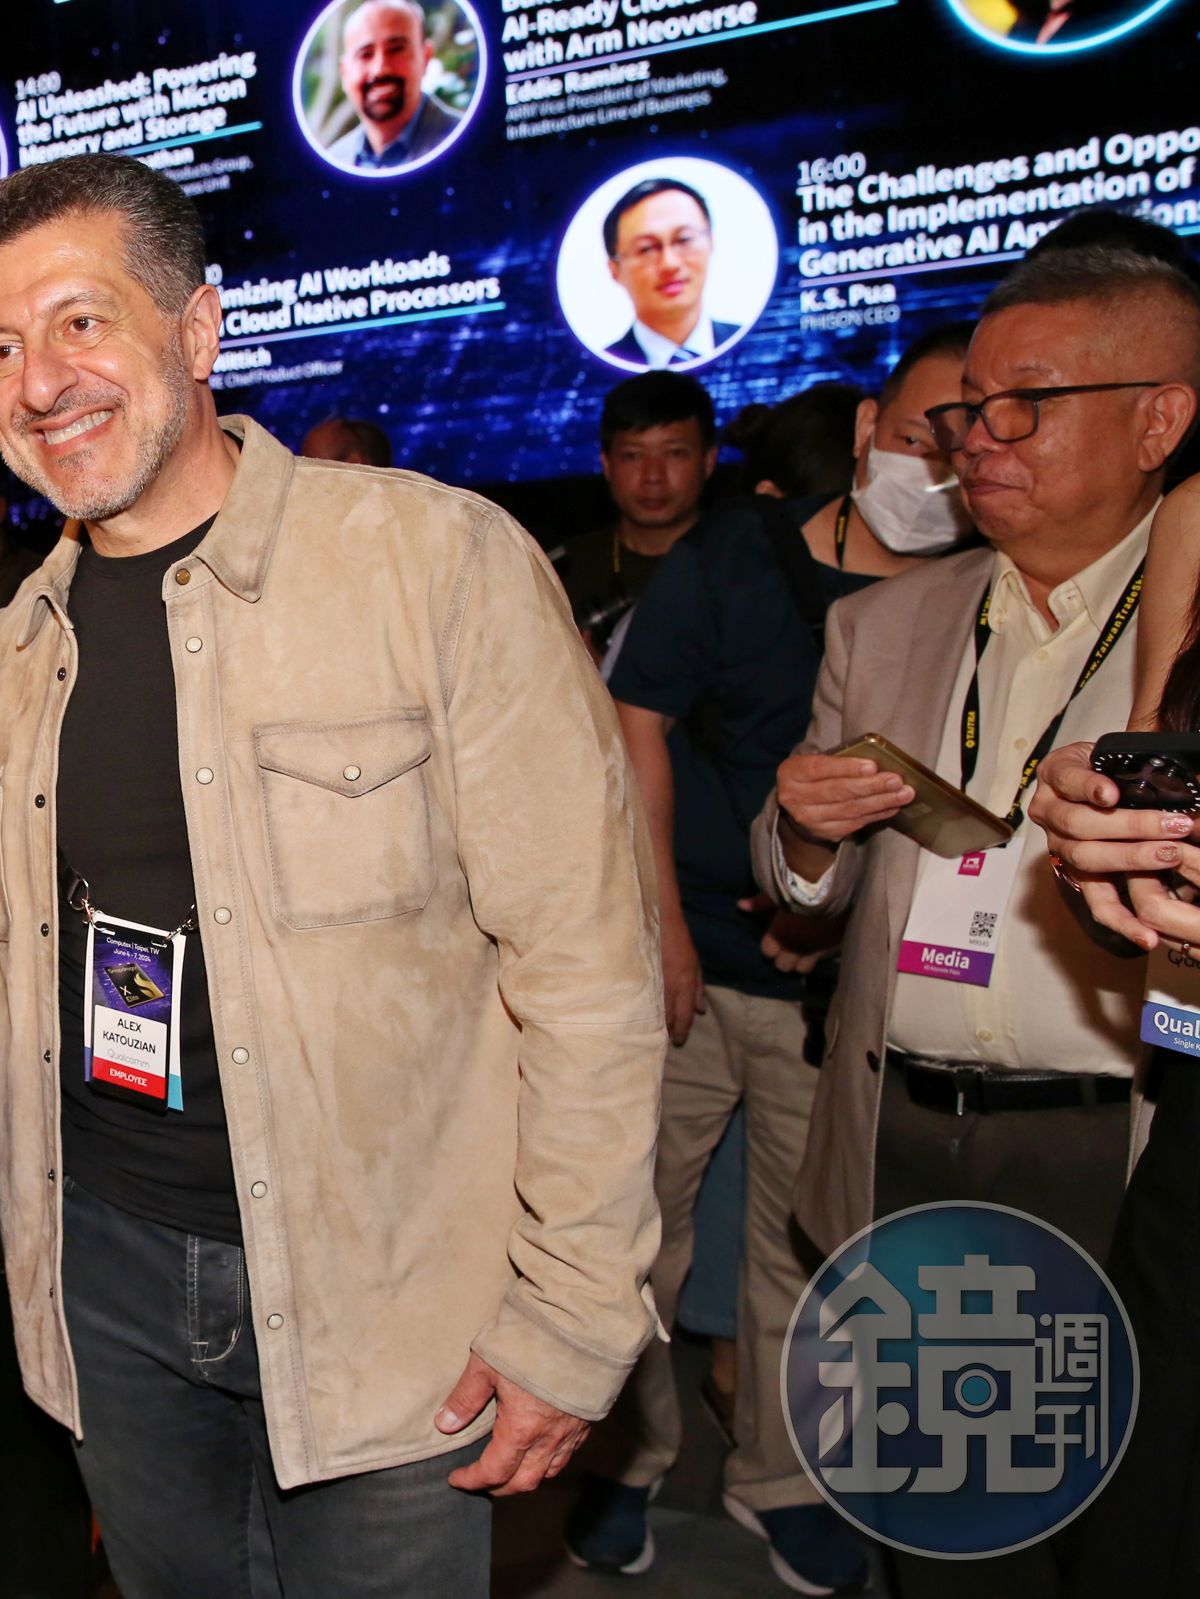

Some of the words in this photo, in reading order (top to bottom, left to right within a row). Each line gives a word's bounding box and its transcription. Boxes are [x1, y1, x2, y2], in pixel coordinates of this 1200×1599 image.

[501, 0, 619, 43] AI-Ready
[503, 37, 564, 72] with
[565, 28, 623, 61] Arm
[626, 1, 758, 48] Neoverse
[15, 71, 61, 100] 14:00
[16, 100, 37, 124] AI
[39, 72, 151, 119] Unleashed:
[153, 51, 257, 91] Powering
[505, 76, 563, 105] Eddie
[565, 60, 650, 93] Ramirez
[17, 120, 51, 145] the
[52, 106, 120, 138] Future
[121, 92, 170, 123] with
[172, 78, 247, 111] Micron
[102, 120, 143, 151] and
[145, 107, 227, 142] Storage
[797, 182, 853, 213] The
[859, 156, 1029, 203] Challenges
[1033, 137, 1099, 176] and
[798, 151, 866, 186] 16:00
[799, 216, 827, 246] in
[831, 209, 884, 240] the
[887, 172, 1150, 233] Implementation
[1155, 156, 1198, 192] of
[799, 233, 963, 278] Generative
[966, 225, 999, 256] AI
[299, 270, 323, 297] AI
[324, 250, 450, 293] Workloads
[226, 305, 291, 336] Cloud
[294, 295, 368, 327] Native
[370, 276, 500, 315] Processors
[800, 287, 847, 313] K.S.
[848, 283, 897, 307] Pua
[863, 304, 901, 325] CEO
[106, 936, 132, 949] Computex
[150, 946, 160, 956] TW
[113, 948, 127, 957] June
[920, 946, 971, 971] Media
[119, 985, 132, 997] X
[117, 1018, 142, 1034] ALEX
[102, 1030, 157, 1055] KATOUZIAN
[107, 1048, 151, 1069] Qualcomm
[1173, 1036, 1195, 1050] Single
[109, 1068, 148, 1088] EMPLOYEE
